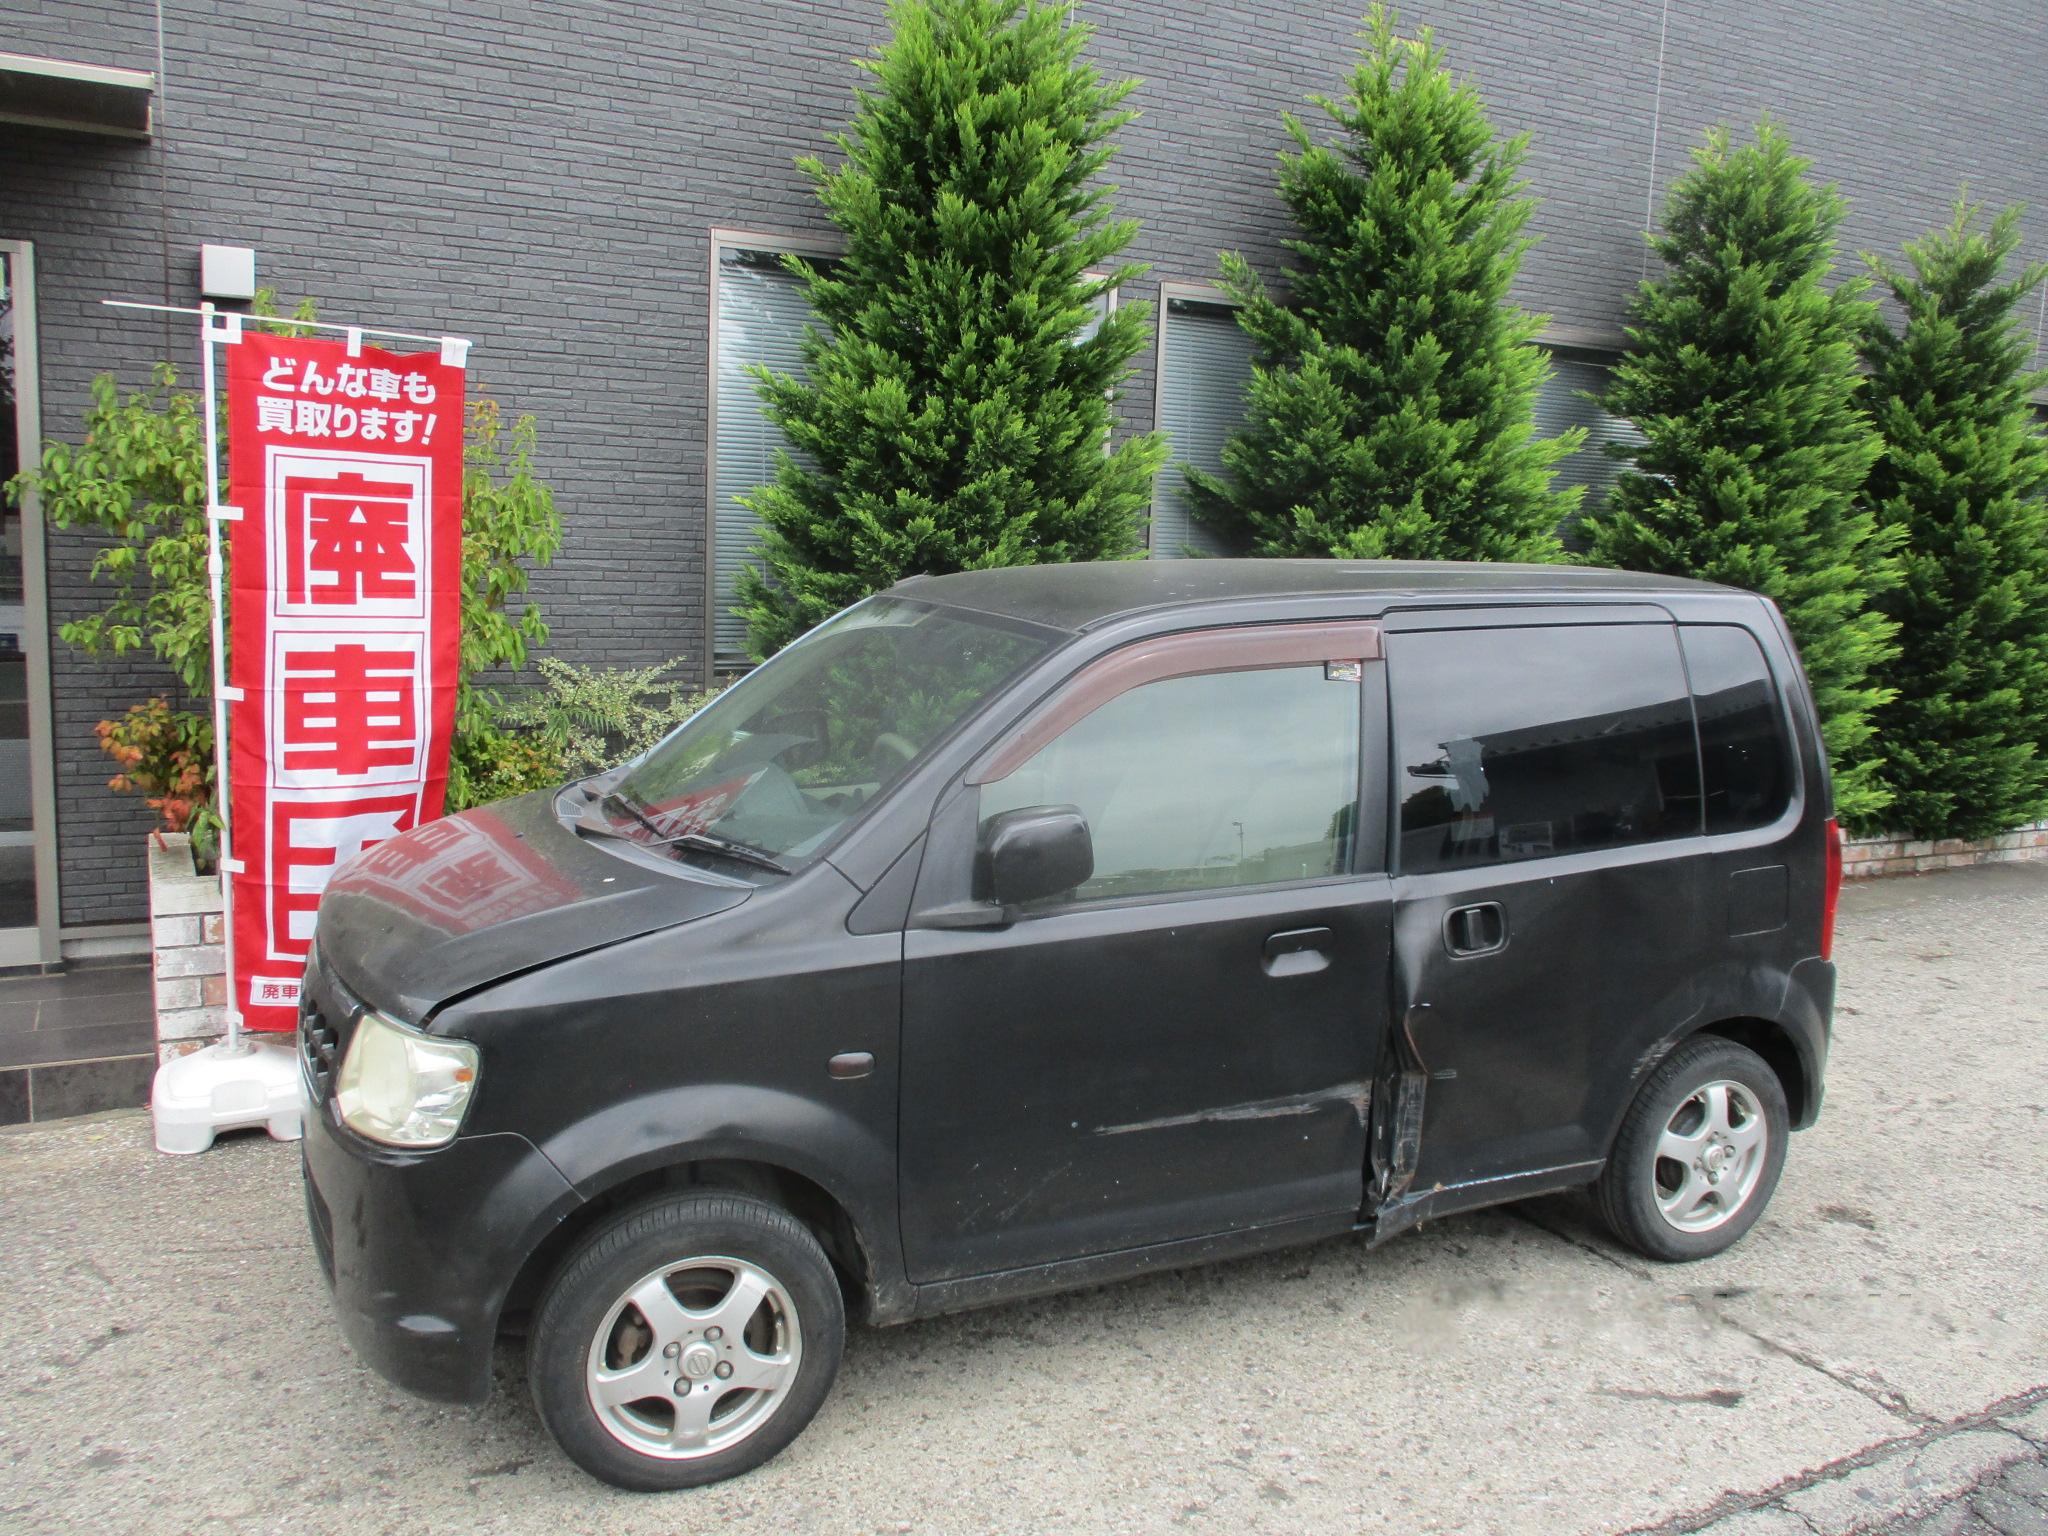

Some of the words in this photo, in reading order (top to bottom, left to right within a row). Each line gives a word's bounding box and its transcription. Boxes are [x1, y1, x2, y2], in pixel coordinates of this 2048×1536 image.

[262, 356, 436, 405] どんな車も
[256, 396, 438, 446] 買取ります!
